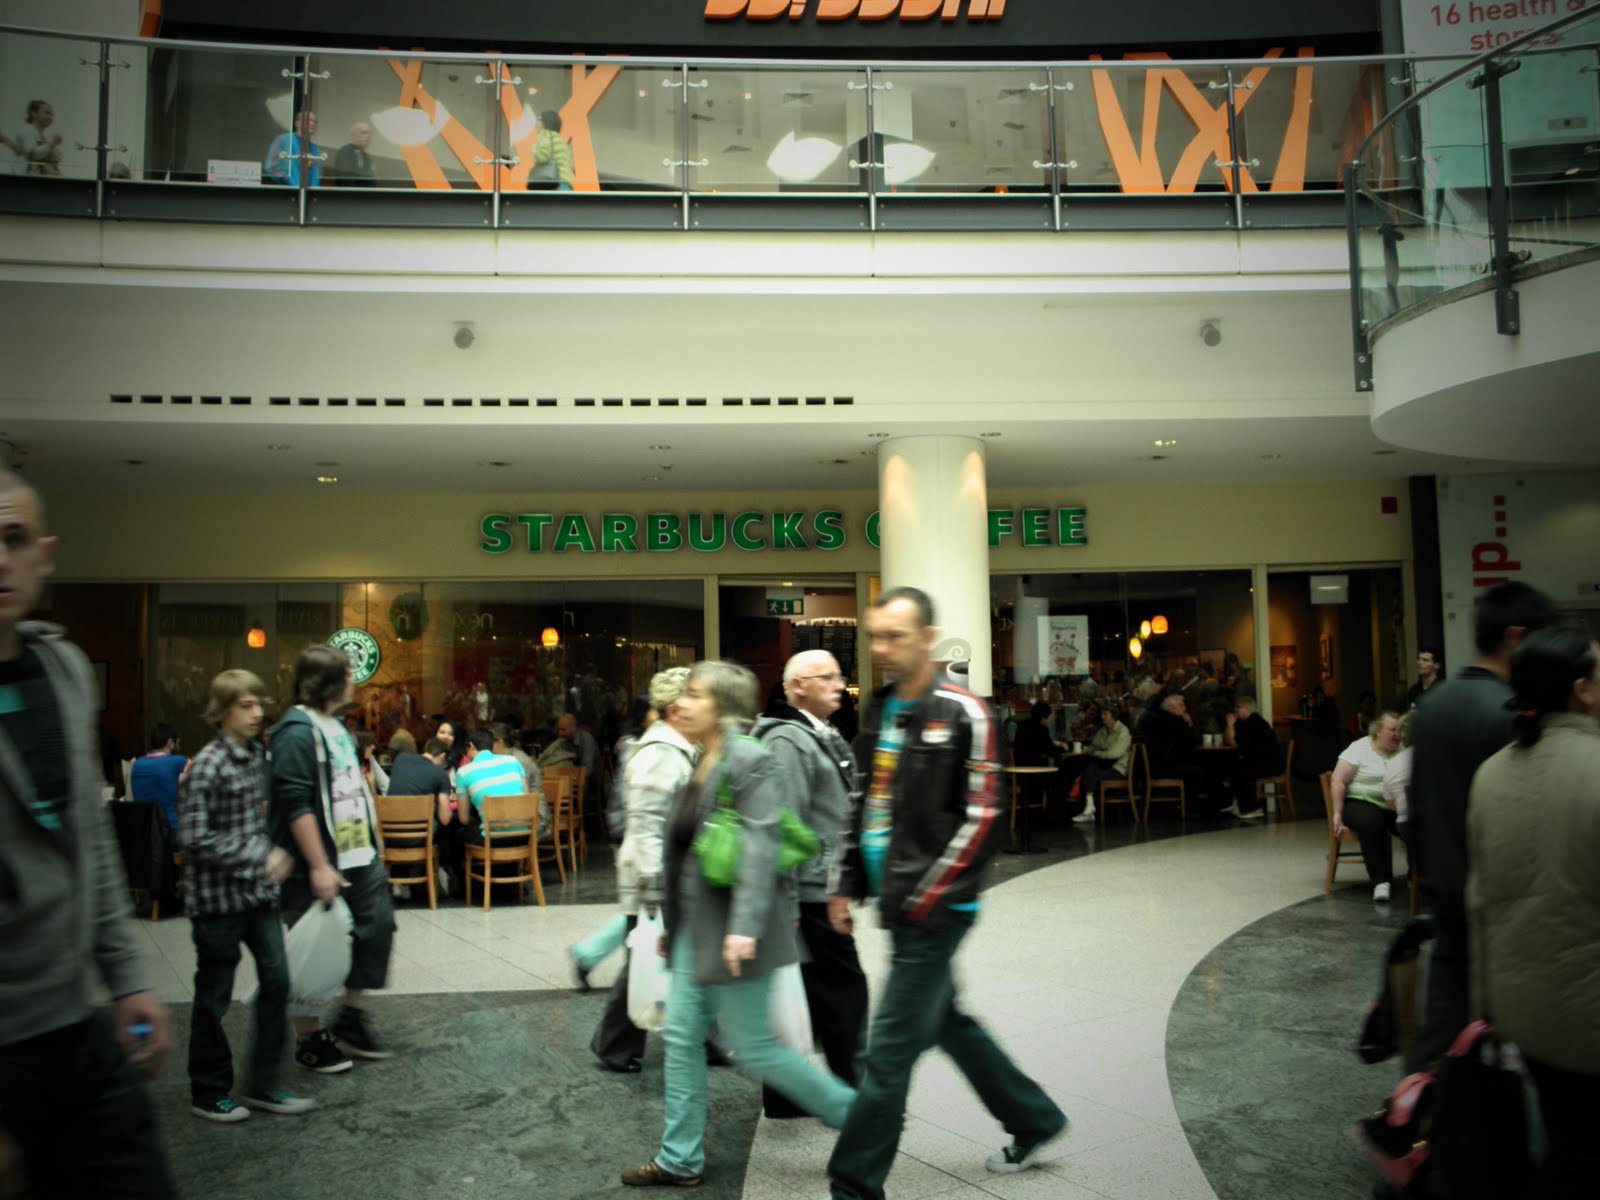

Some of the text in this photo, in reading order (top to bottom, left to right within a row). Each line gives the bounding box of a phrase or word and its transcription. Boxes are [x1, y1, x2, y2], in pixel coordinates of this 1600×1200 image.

[1431, 3, 1461, 27] 16
[1469, 0, 1557, 23] health
[480, 507, 1088, 553] STARBUCKS FEE
[329, 630, 376, 654] TARBUCKS
